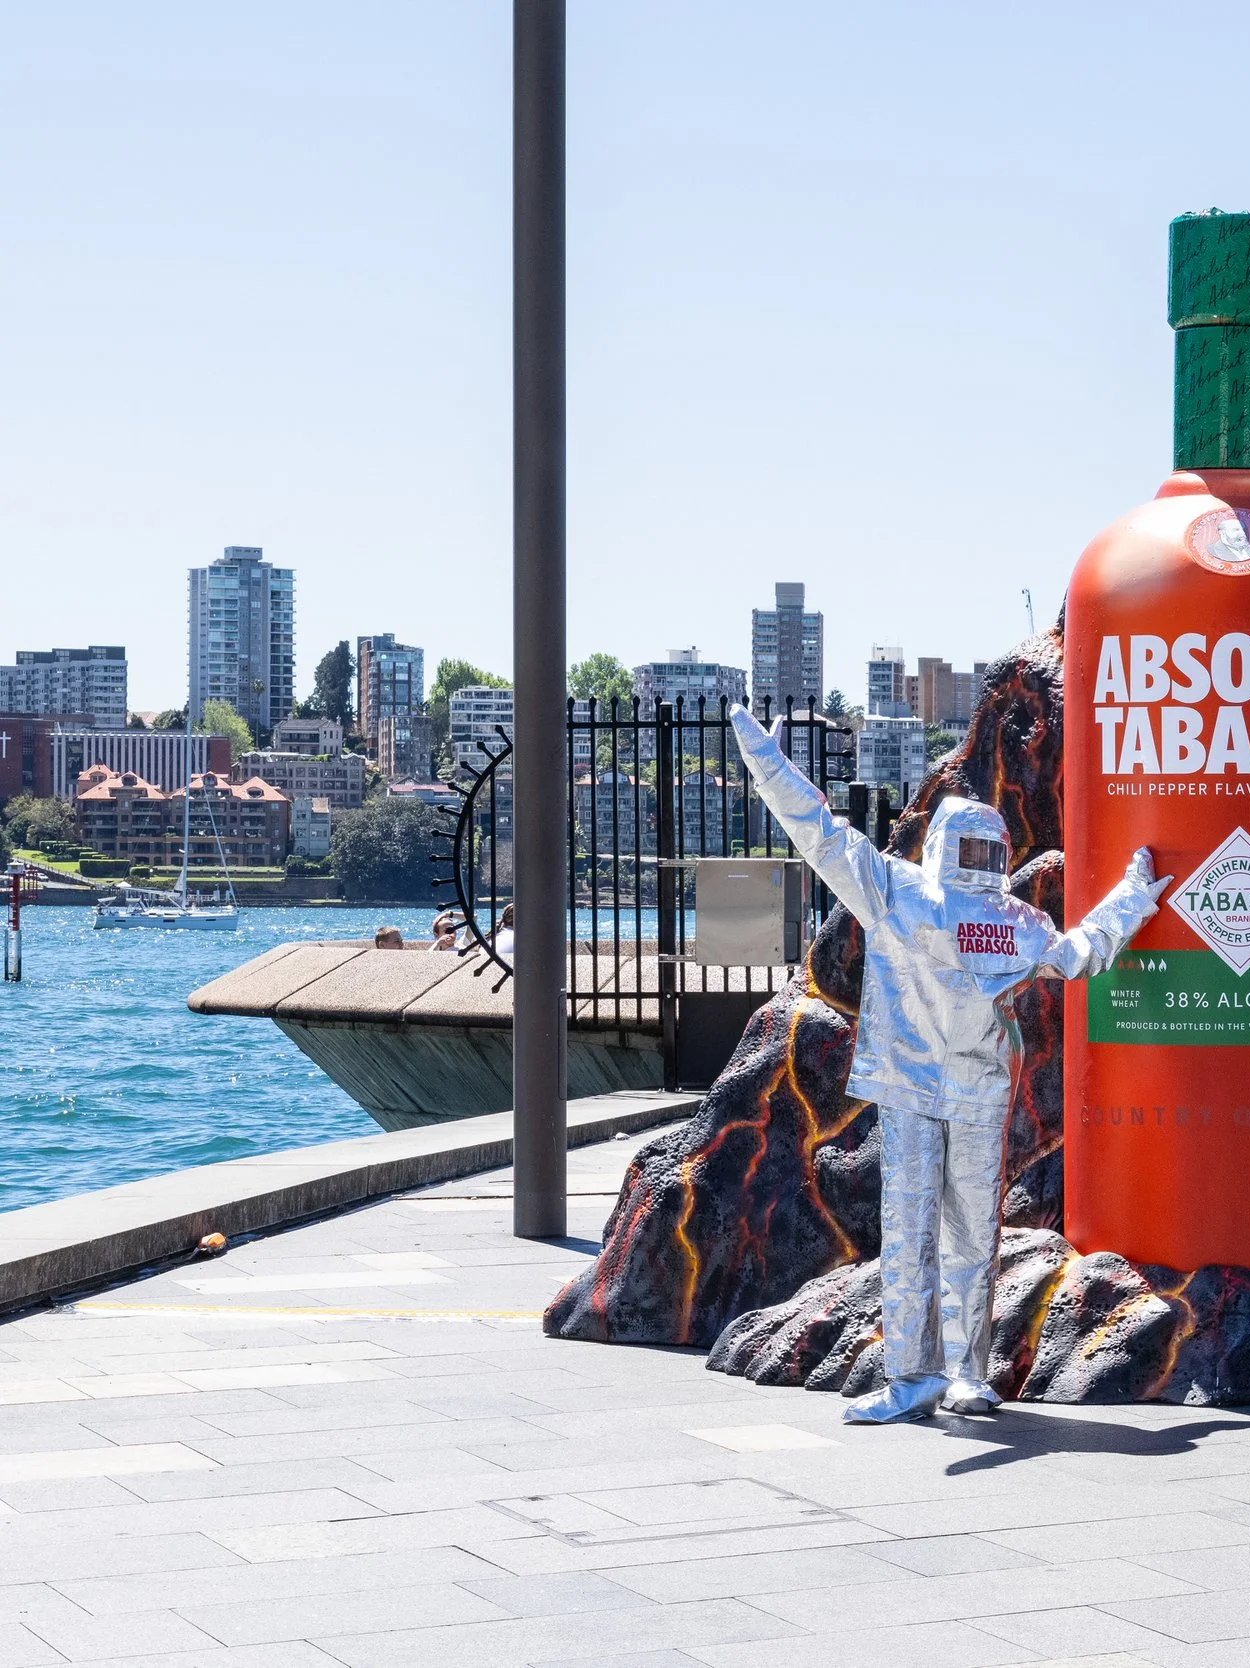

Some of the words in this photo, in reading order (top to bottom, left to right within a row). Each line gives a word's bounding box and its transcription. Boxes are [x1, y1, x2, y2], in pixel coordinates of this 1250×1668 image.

[1107, 782, 1142, 796] CHILI
[1149, 782, 1208, 796] PEPPER
[957, 922, 1016, 940] ABSOLUT
[1203, 915, 1242, 943] PEPPER
[1110, 990, 1141, 998] WINTER
[1165, 991, 1209, 1008] 38%
[1111, 1000, 1139, 1008] WHEAT
[1116, 1021, 1160, 1030] PRODUCED
[1161, 1022, 1168, 1030] &
[1170, 1022, 1211, 1031] BOTTLED
[1214, 1023, 1224, 1031] IN
[1228, 1022, 1245, 1031] THE
